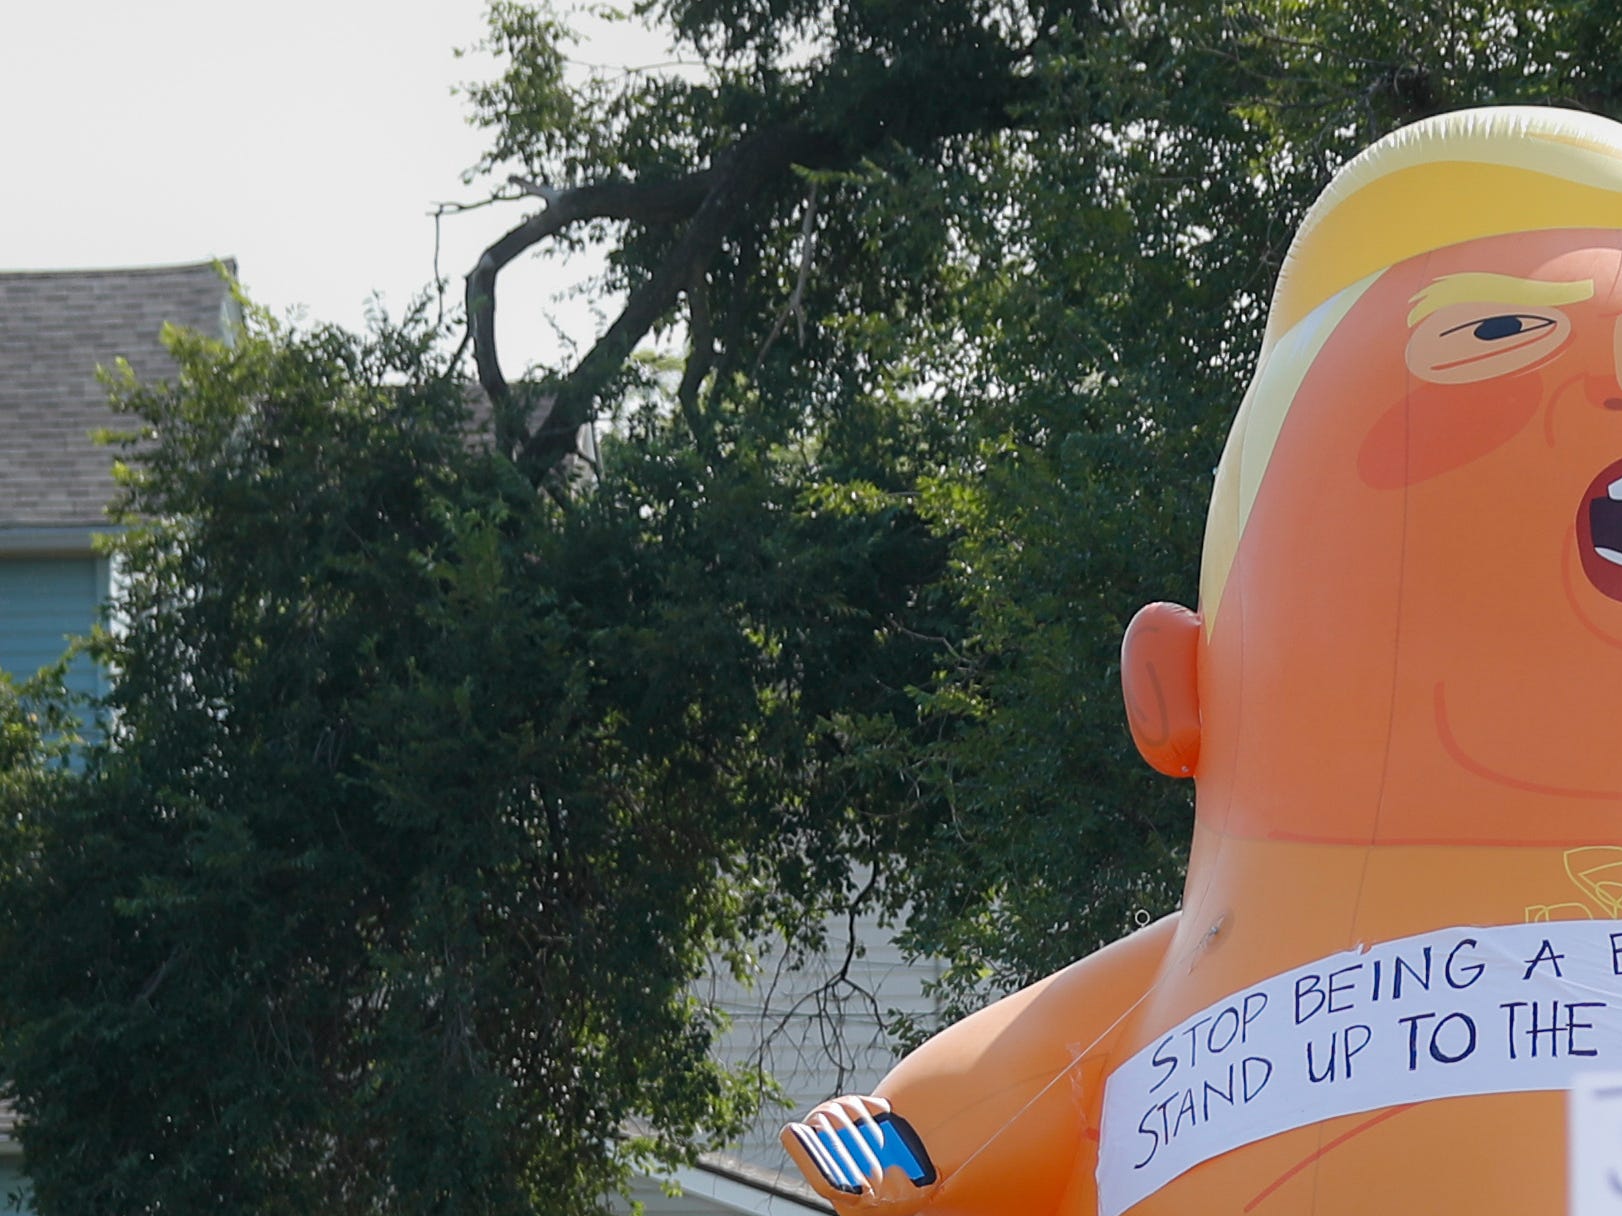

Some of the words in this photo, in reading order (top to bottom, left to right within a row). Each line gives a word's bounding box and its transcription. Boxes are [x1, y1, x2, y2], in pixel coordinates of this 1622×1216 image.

[1133, 1056, 1273, 1170] STAND
[1306, 1024, 1372, 1083] UP
[1400, 1012, 1477, 1071] TO
[1500, 1001, 1607, 1060] THE
[1149, 993, 1268, 1094] STOP
[1294, 939, 1486, 1025] BEING
[1523, 940, 1565, 980] A
